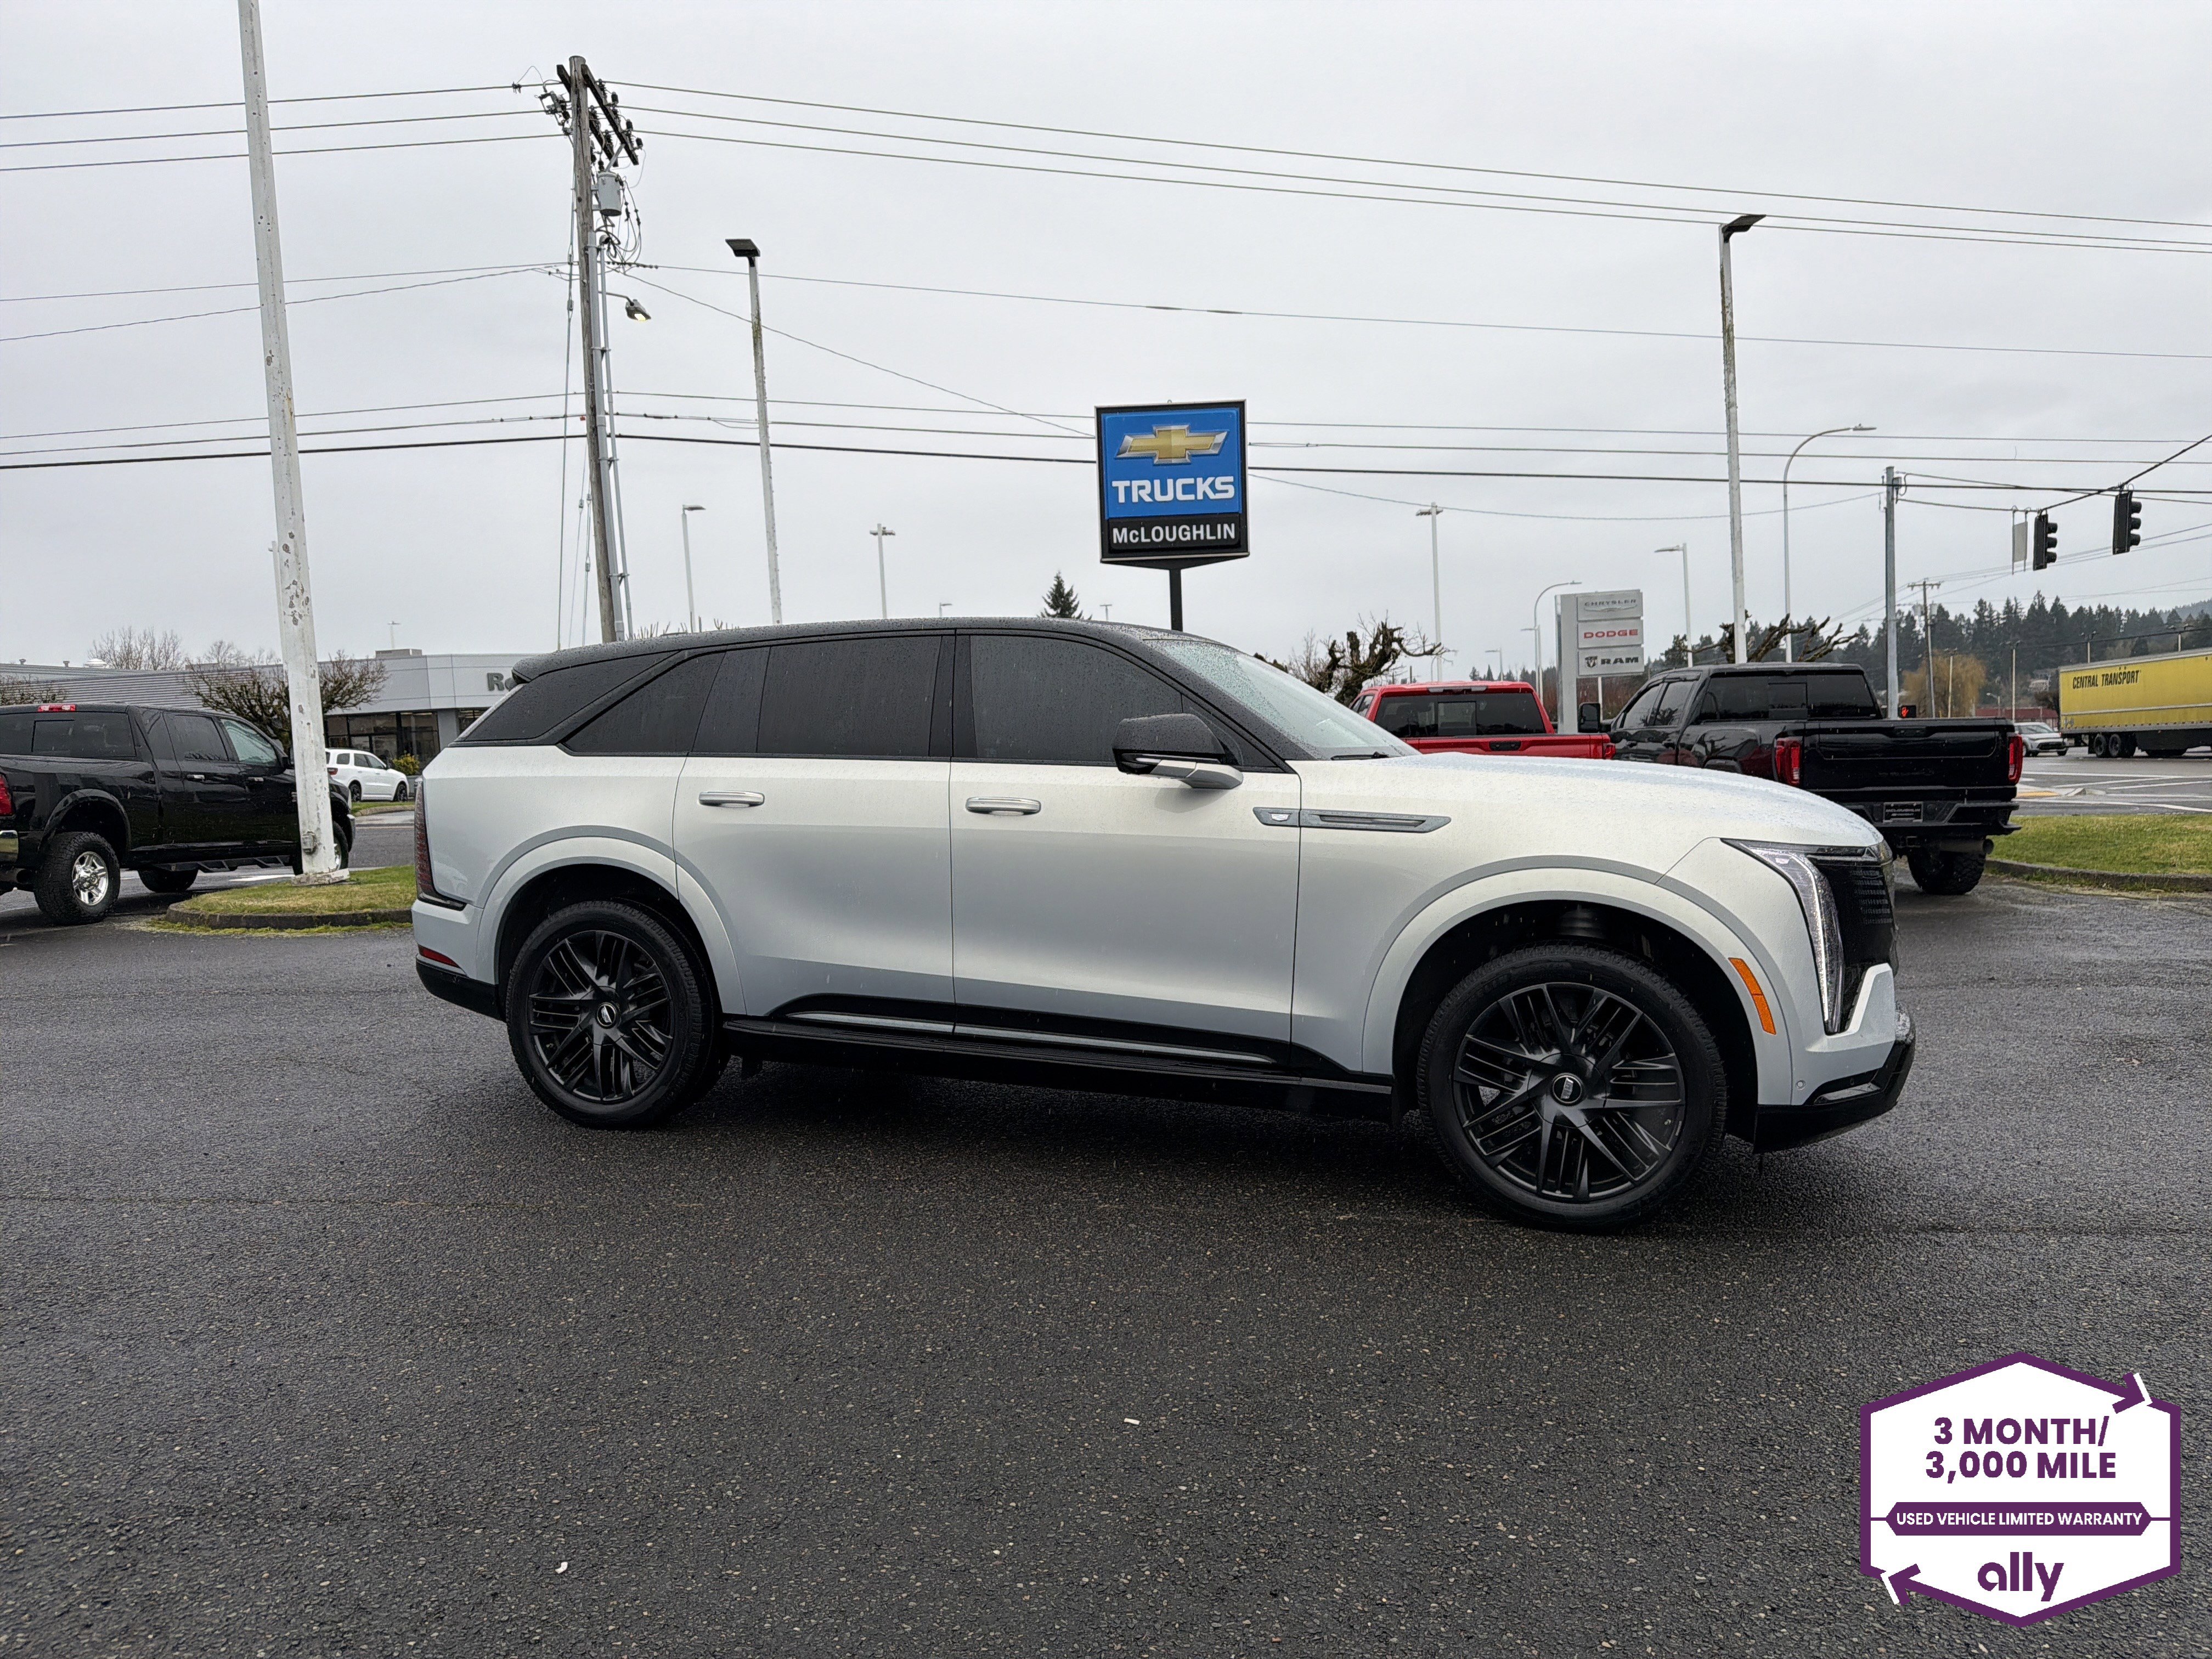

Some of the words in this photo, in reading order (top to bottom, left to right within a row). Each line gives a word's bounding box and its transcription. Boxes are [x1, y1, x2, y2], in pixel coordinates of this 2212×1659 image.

[1112, 476, 1234, 503] TRUCKS
[1114, 524, 1234, 543] McLOUGHLIN
[1583, 629, 1638, 639] DODGE
[1600, 657, 1639, 665] RAM
[2073, 674, 2098, 689] CENTRAL
[2101, 670, 2140, 686] TRANSPORT
